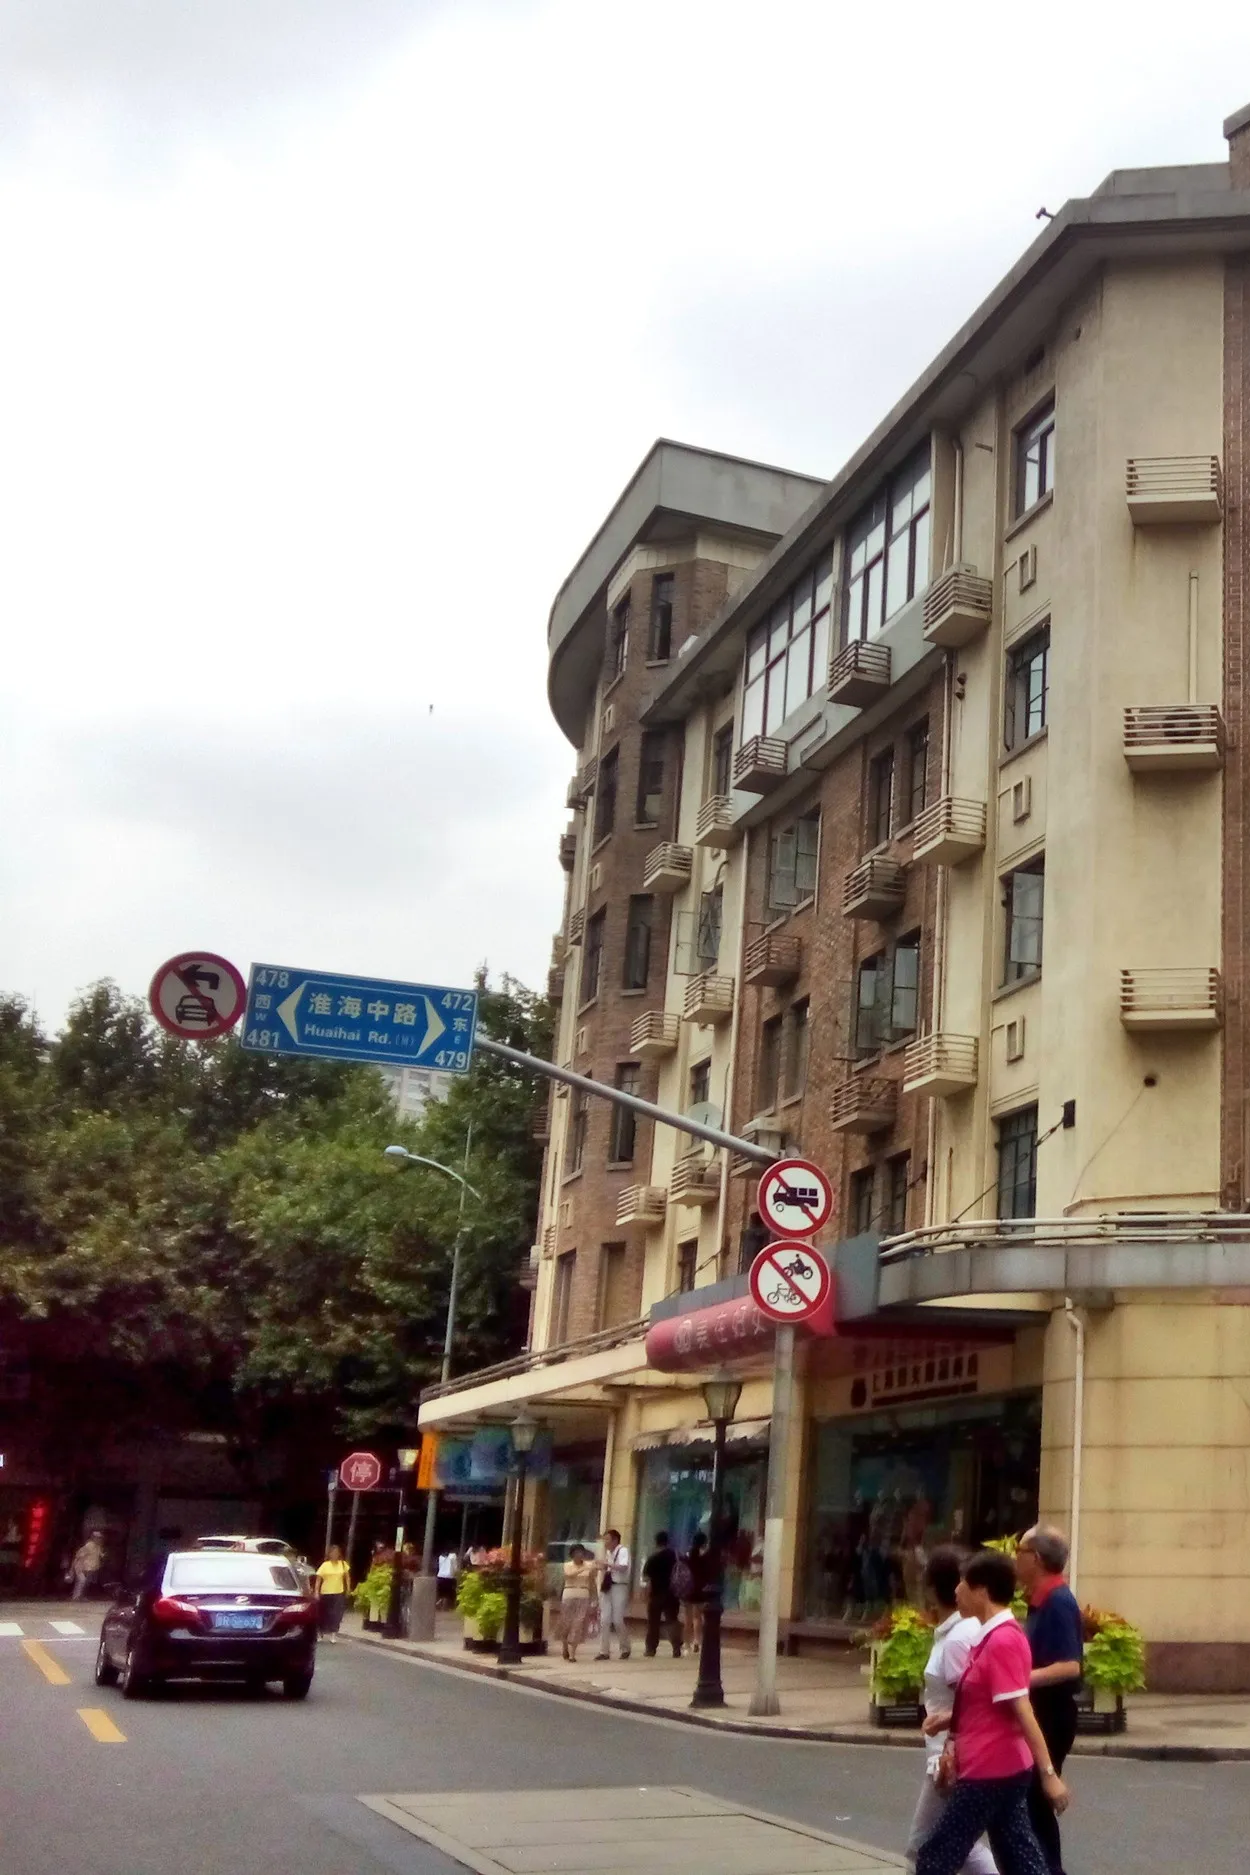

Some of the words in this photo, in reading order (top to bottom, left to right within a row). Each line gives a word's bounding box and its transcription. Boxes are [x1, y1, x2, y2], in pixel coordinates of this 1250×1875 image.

[256, 968, 290, 989] 478
[255, 994, 272, 1010] 西
[307, 992, 418, 1026] 淮海中路
[441, 992, 473, 1012] 472
[255, 1012, 268, 1021] W
[452, 1017, 468, 1033] 东
[247, 1028, 280, 1049] 481
[304, 1023, 361, 1042] Huaihai
[368, 1031, 392, 1045] Rd.
[454, 1035, 461, 1045] E
[434, 1050, 467, 1069] 479
[350, 1460, 373, 1483] 停
